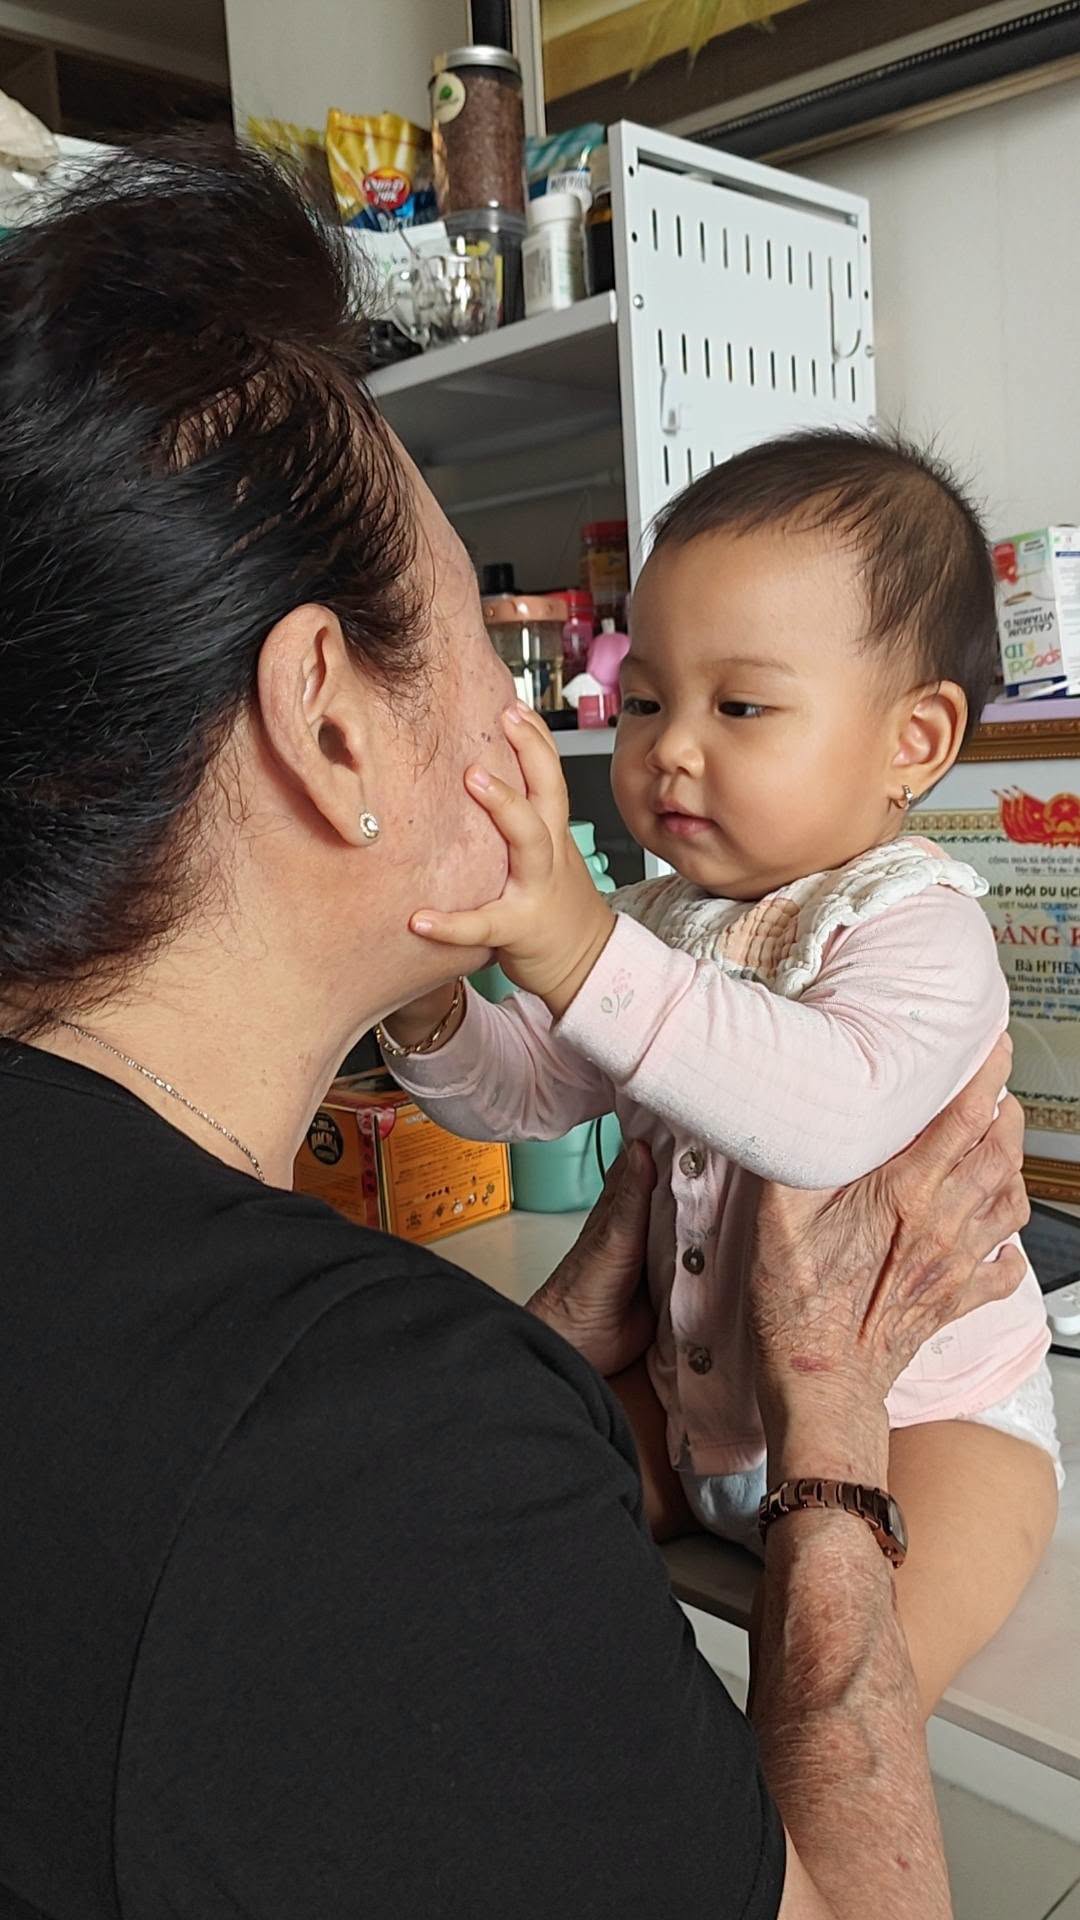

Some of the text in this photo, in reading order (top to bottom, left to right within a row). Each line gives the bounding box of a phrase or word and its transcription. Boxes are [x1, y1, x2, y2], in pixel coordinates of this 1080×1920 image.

[1013, 611, 1055, 626] VITAMIN
[1009, 623, 1053, 638] CALCIUM
[1015, 883, 1036, 898] HỘI
[1040, 886, 1057, 897] DU
[1015, 959, 1032, 972] Bà
